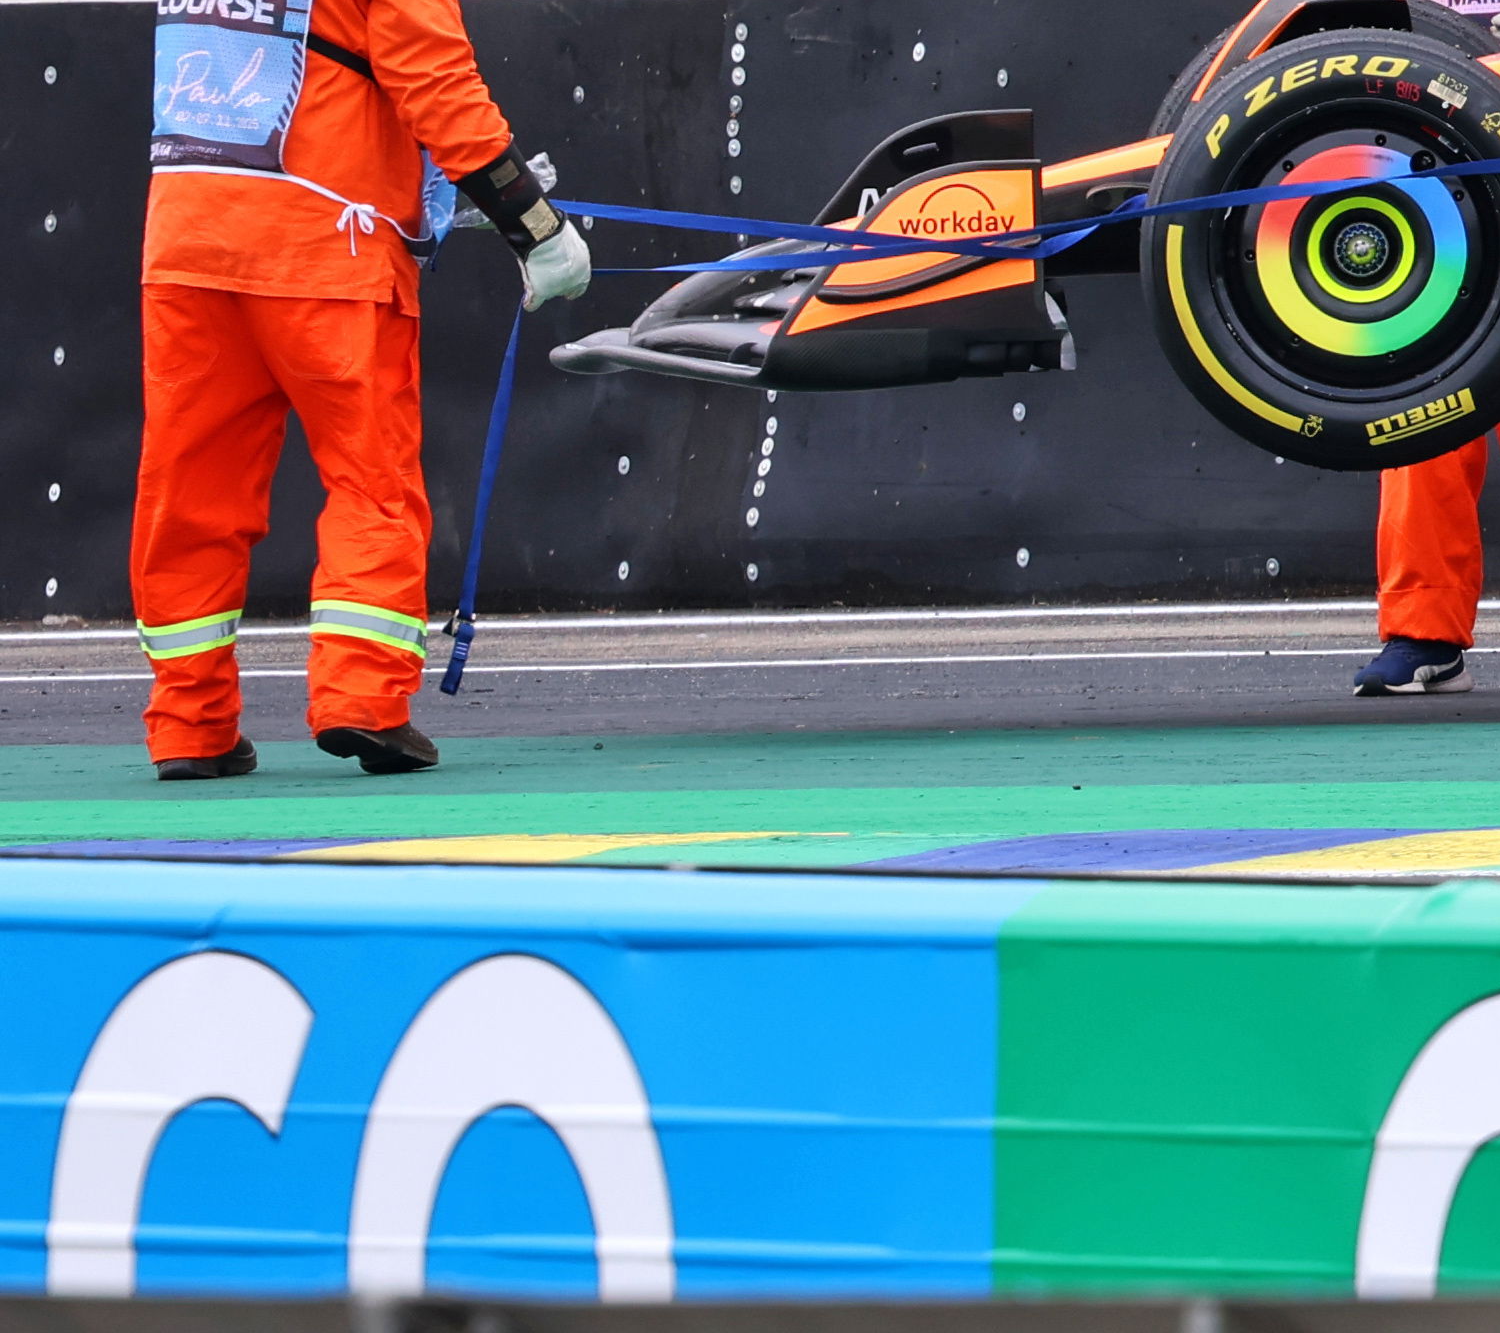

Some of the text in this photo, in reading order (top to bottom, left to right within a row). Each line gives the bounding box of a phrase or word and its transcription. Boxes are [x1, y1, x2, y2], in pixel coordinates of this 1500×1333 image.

[1205, 54, 1412, 159] P ZERO
[898, 209, 1016, 236] workday
[1365, 387, 1476, 446] PIRELLI
